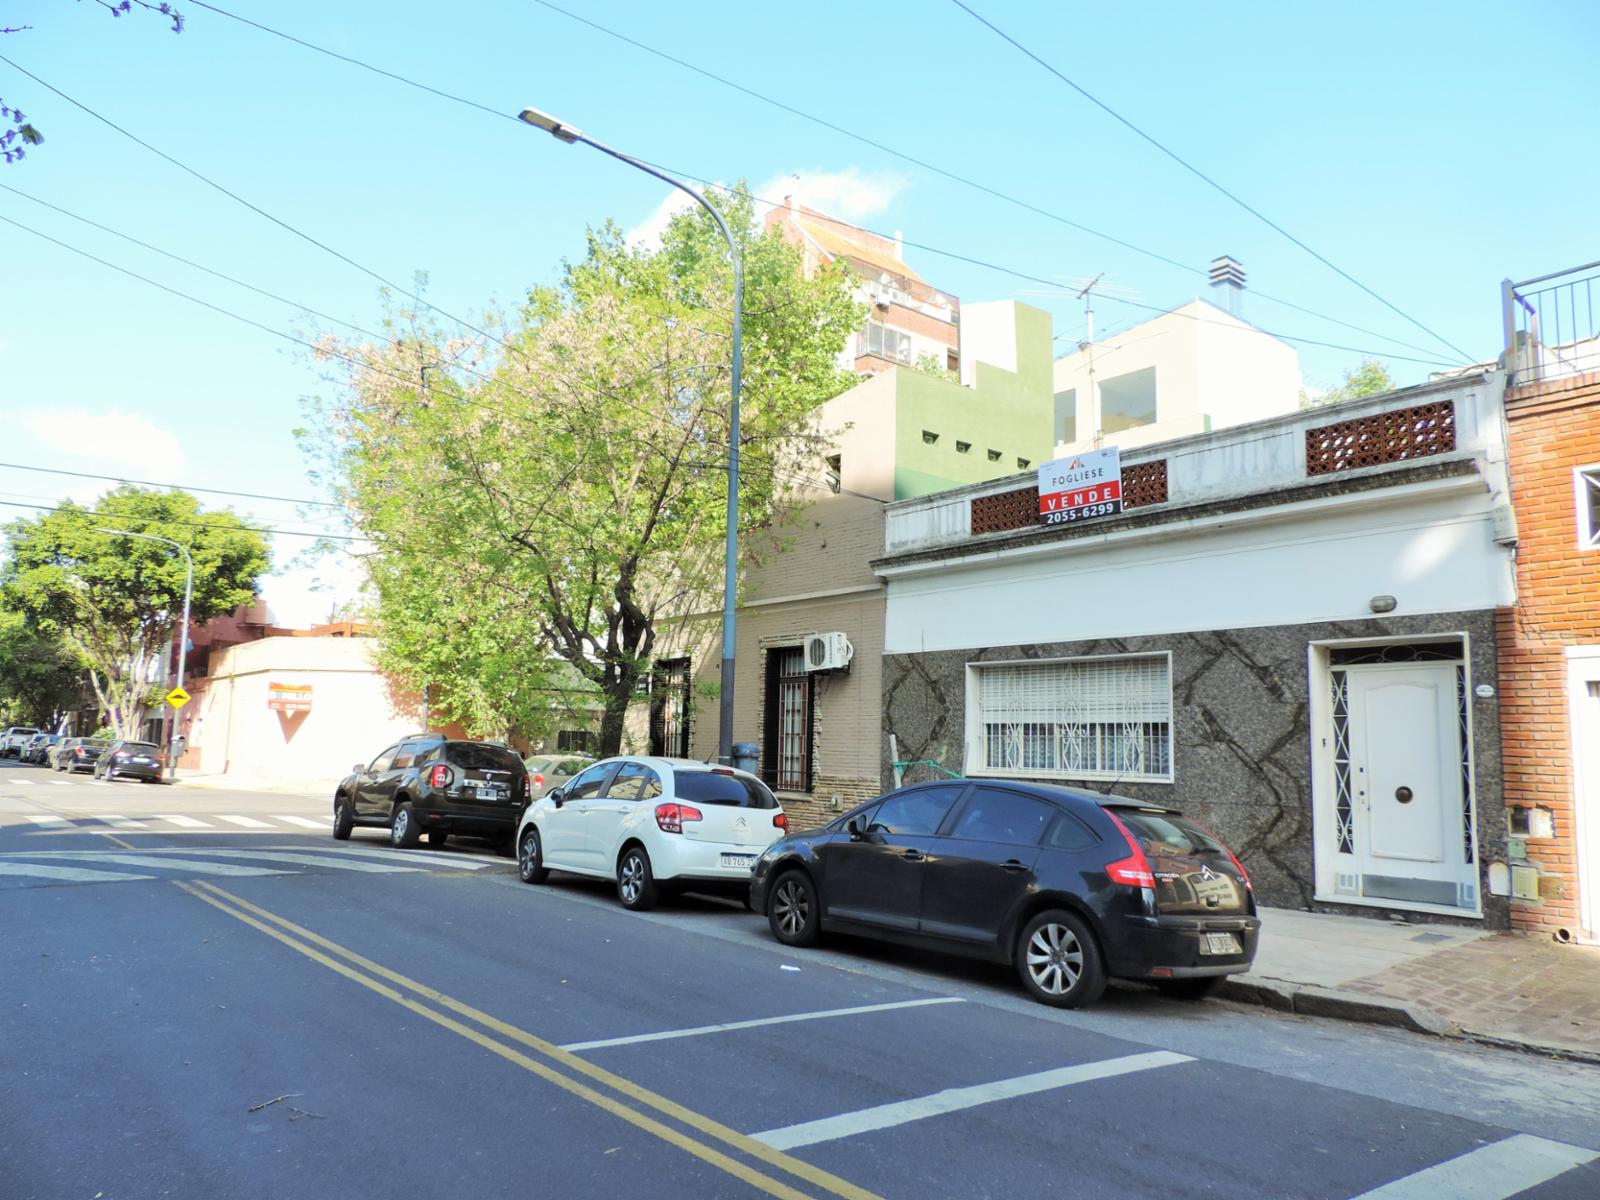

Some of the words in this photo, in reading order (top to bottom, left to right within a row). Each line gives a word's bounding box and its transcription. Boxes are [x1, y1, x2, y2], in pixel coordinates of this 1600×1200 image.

[1052, 468, 1104, 486] FOGLIESE
[1047, 488, 1112, 510] VENDE
[1047, 503, 1114, 524] 2055-6299
